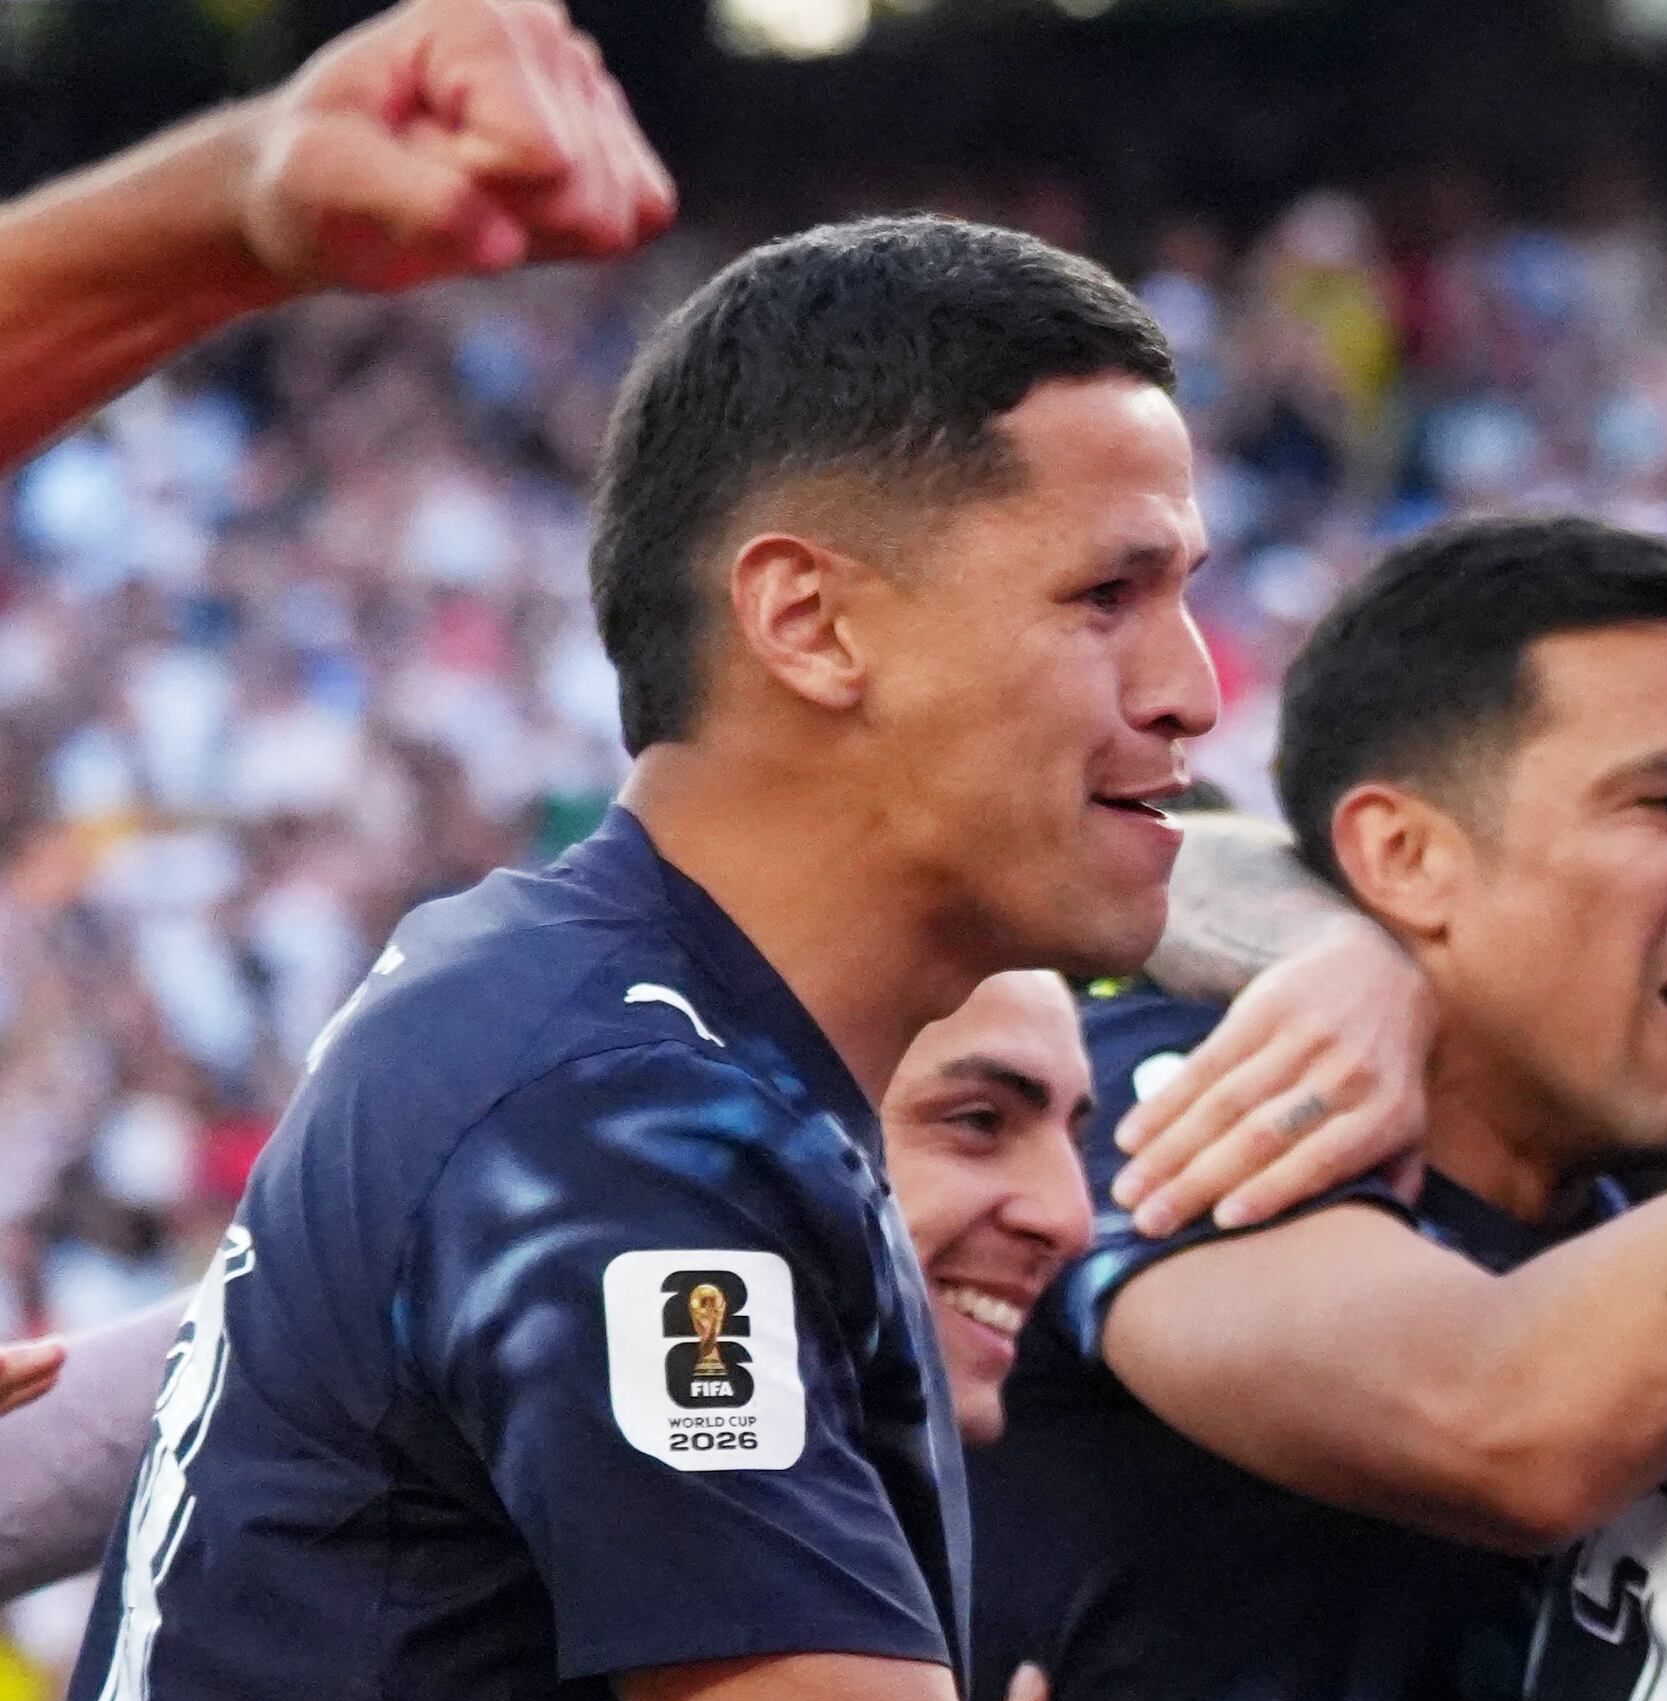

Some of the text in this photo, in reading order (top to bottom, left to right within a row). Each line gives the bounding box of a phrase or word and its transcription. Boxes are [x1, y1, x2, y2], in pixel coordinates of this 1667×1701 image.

[690, 1380, 734, 1398] FIFA
[668, 1416, 758, 1429] WORLD CUP
[668, 1431, 759, 1451] 2026
